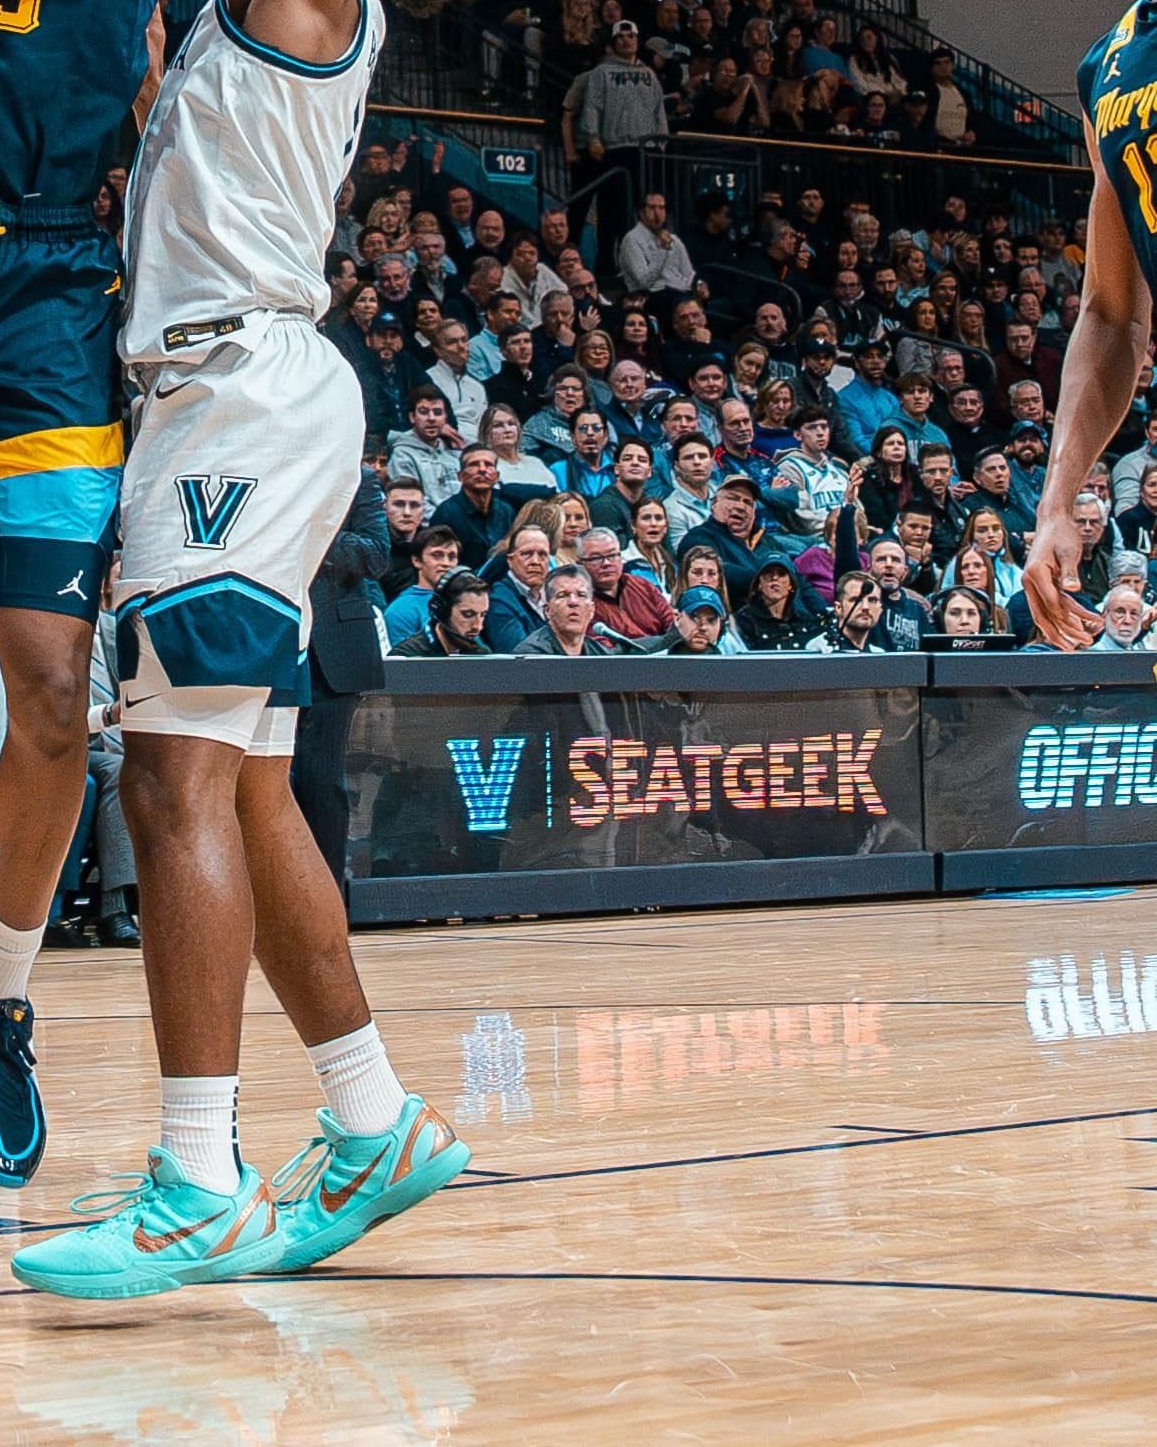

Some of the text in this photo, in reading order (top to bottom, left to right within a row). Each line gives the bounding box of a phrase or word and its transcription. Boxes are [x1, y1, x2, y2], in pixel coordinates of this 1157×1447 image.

[1094, 81, 1157, 146] Marq
[496, 154, 526, 171] 102
[1123, 133, 1157, 234] 1
[174, 474, 258, 550] V
[445, 728, 888, 832] V SEATGEEK
